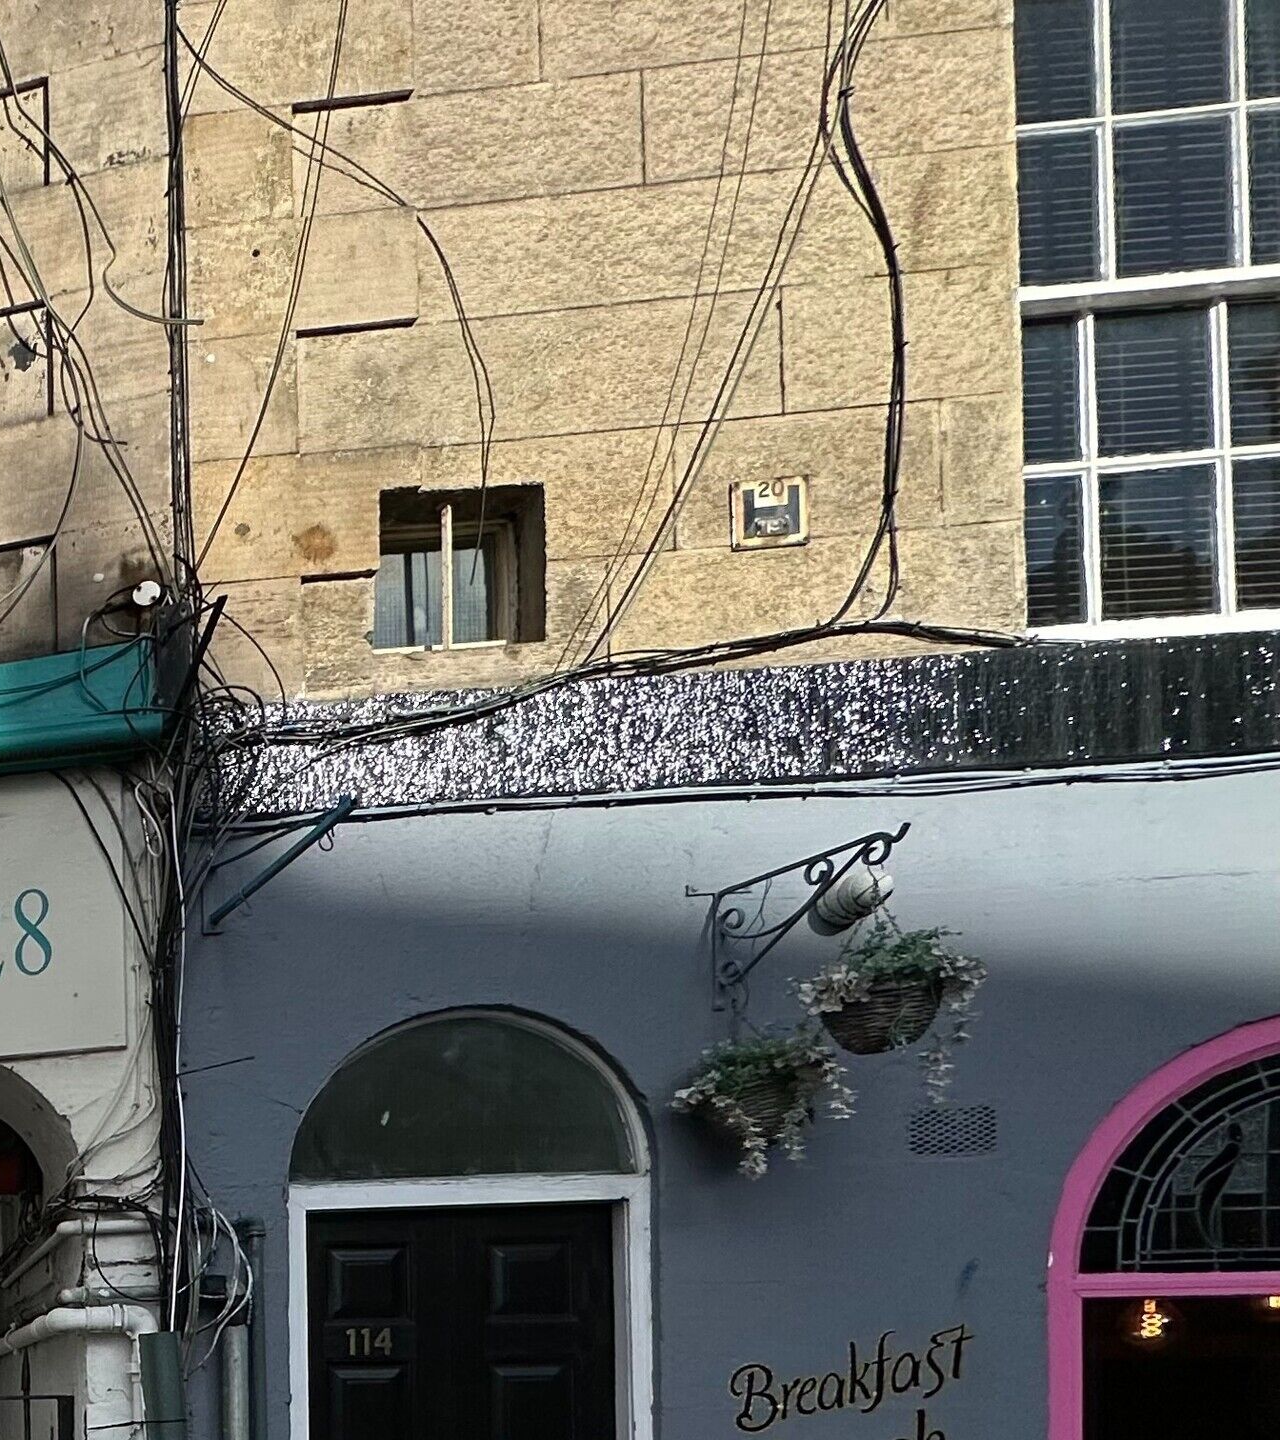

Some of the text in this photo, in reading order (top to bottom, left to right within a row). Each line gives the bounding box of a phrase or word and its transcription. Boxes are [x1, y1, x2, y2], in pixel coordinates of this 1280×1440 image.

[758, 480, 785, 498] 20
[345, 1327, 393, 1356] 114
[730, 1324, 975, 1432] Breakfast
